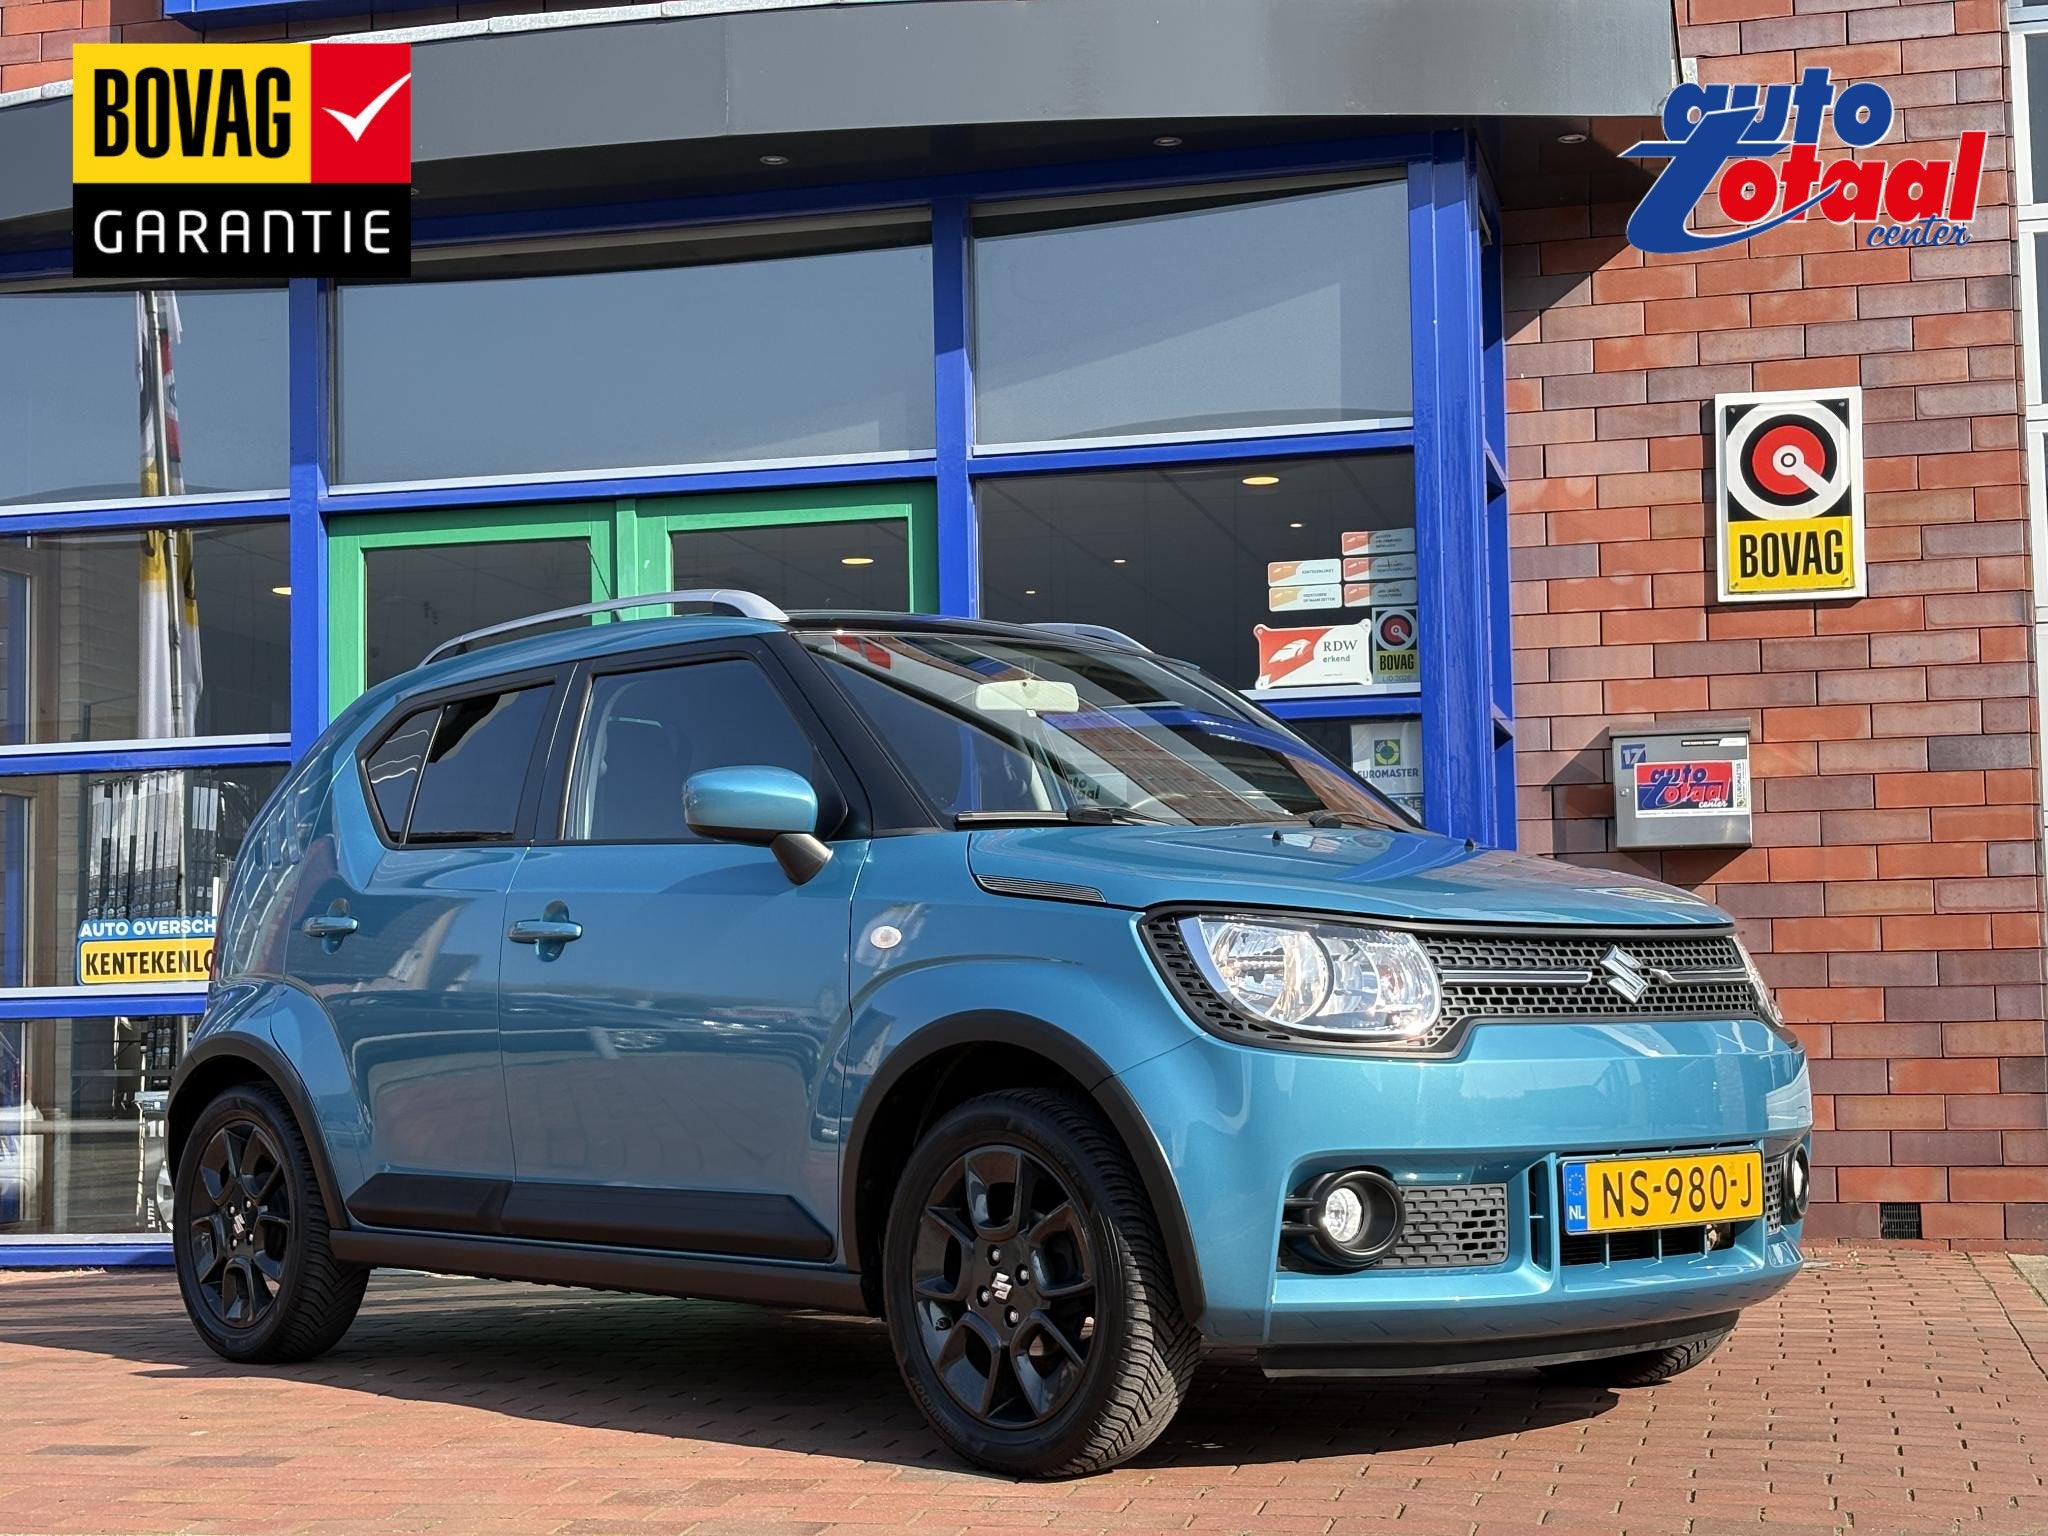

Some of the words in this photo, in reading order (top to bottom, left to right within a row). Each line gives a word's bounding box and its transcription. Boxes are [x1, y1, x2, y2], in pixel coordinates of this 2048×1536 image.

[1739, 529, 1844, 578] BOVAG
[1323, 640, 1358, 652] RDW
[1322, 655, 1351, 663] erkend
[1380, 654, 1414, 670] BOVAG
[1622, 748, 1646, 765] 17
[1699, 798, 1728, 808] center
[80, 921, 129, 938] AUTO
[1602, 1163, 1752, 1219] NS-980-J
[1569, 1204, 1586, 1220] NL
